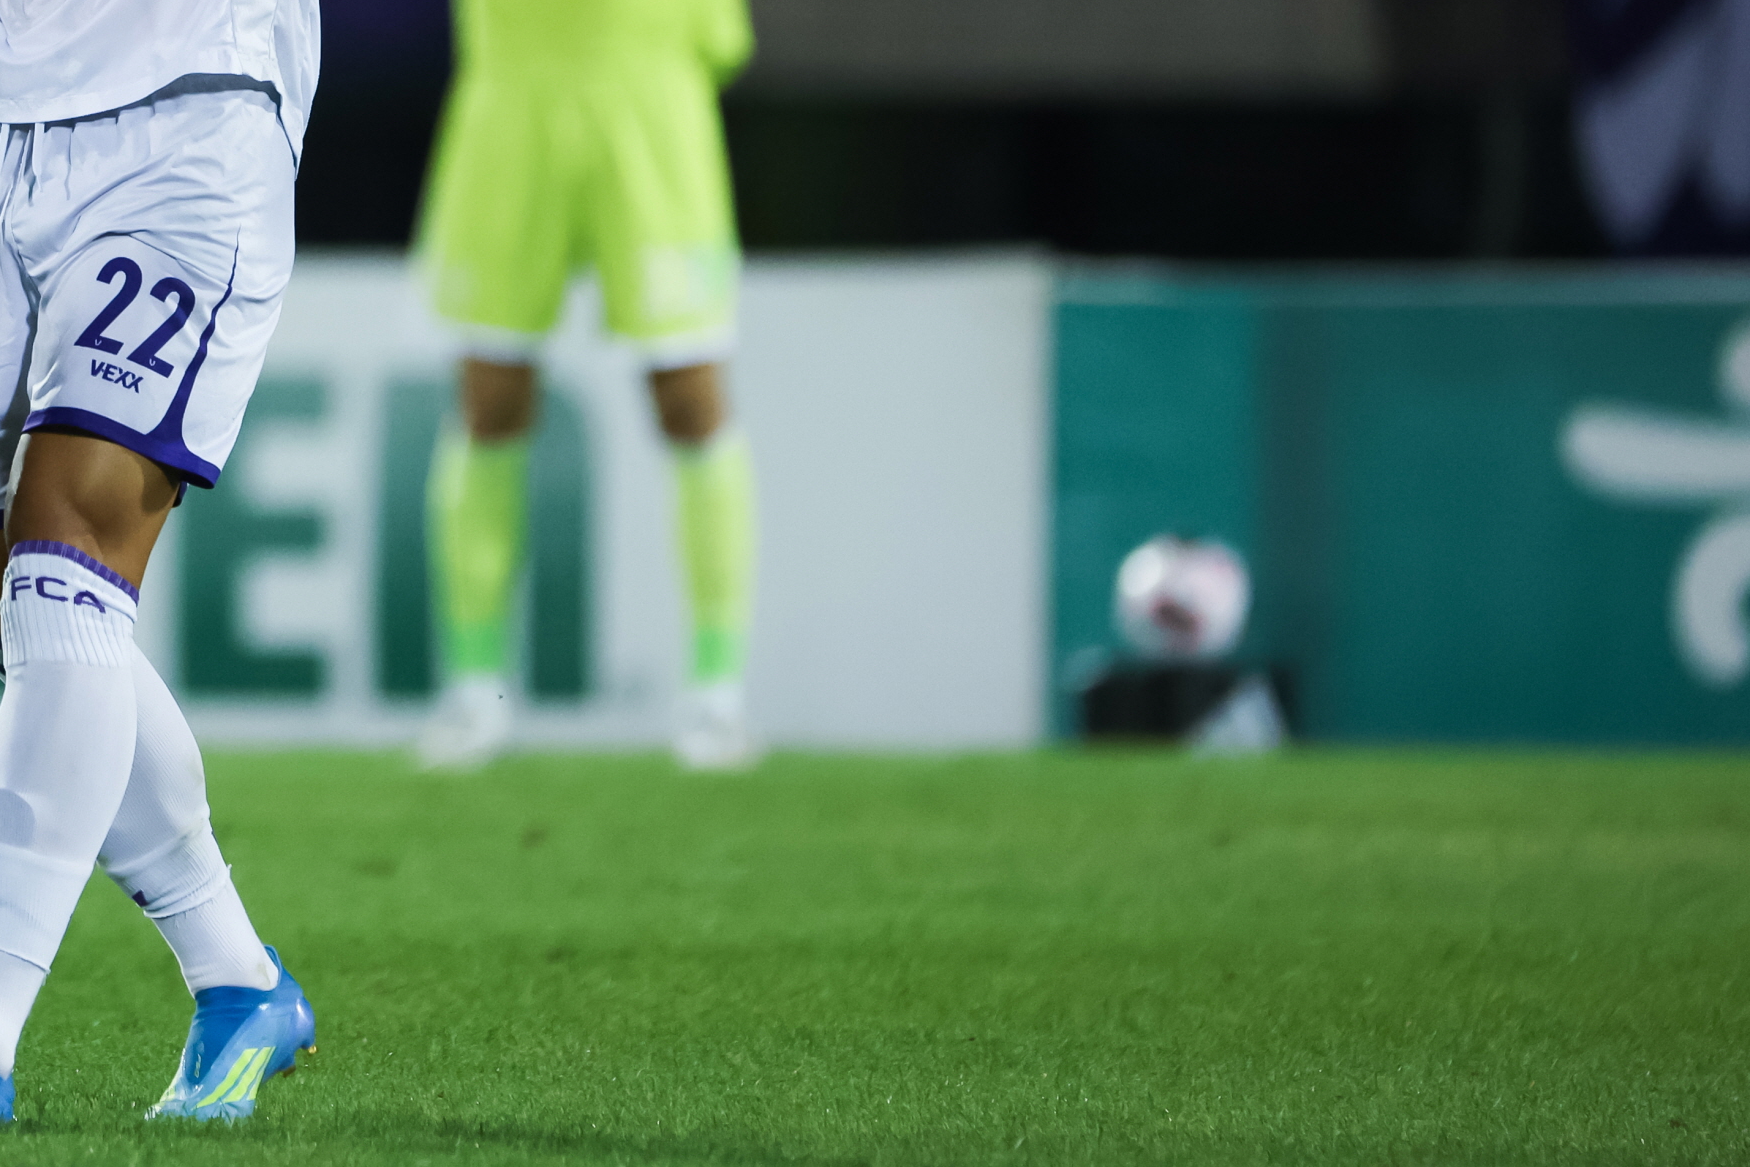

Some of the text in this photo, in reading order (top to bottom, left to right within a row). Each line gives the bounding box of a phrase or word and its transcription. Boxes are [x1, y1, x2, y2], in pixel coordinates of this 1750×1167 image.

[74, 256, 196, 378] 22
[90, 359, 144, 394] VEXX
[11, 575, 106, 614] FCA
